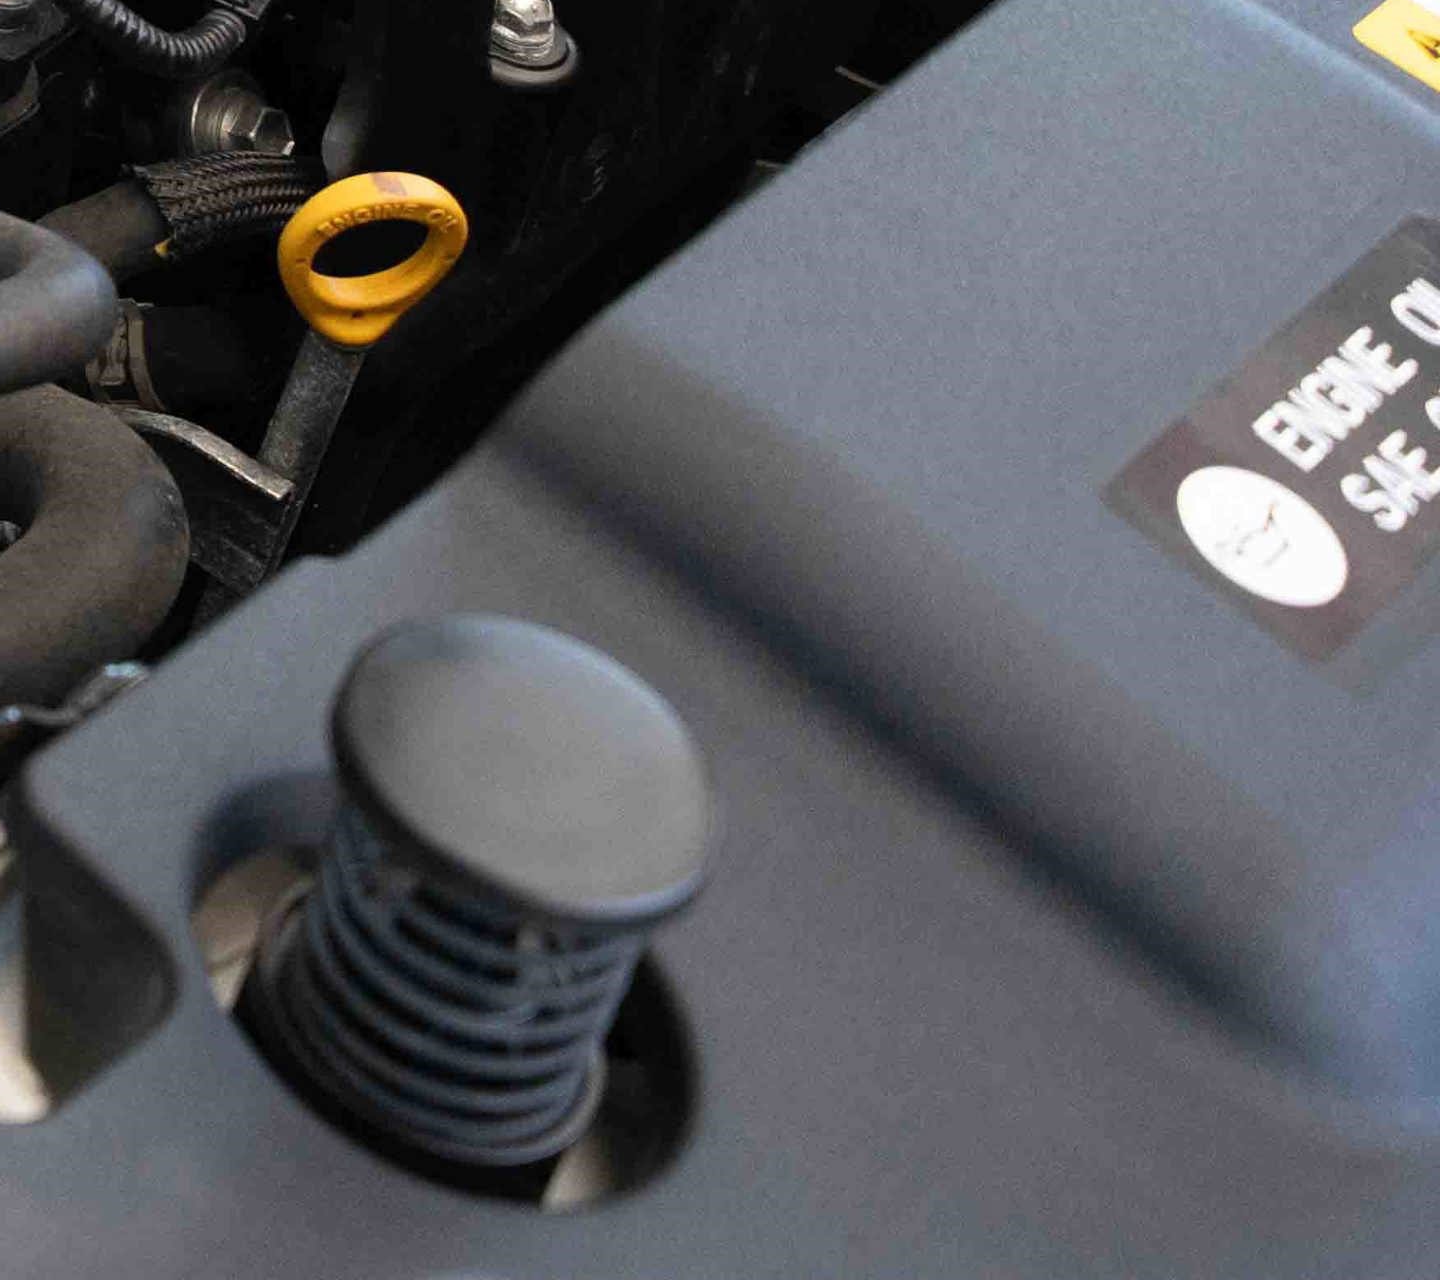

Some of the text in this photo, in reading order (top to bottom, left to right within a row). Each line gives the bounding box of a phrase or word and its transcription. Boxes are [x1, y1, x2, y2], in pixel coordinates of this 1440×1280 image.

[316, 202, 420, 239] ENGINE
[1251, 325, 1420, 474] ENGINE
[1340, 428, 1440, 533] SAE
